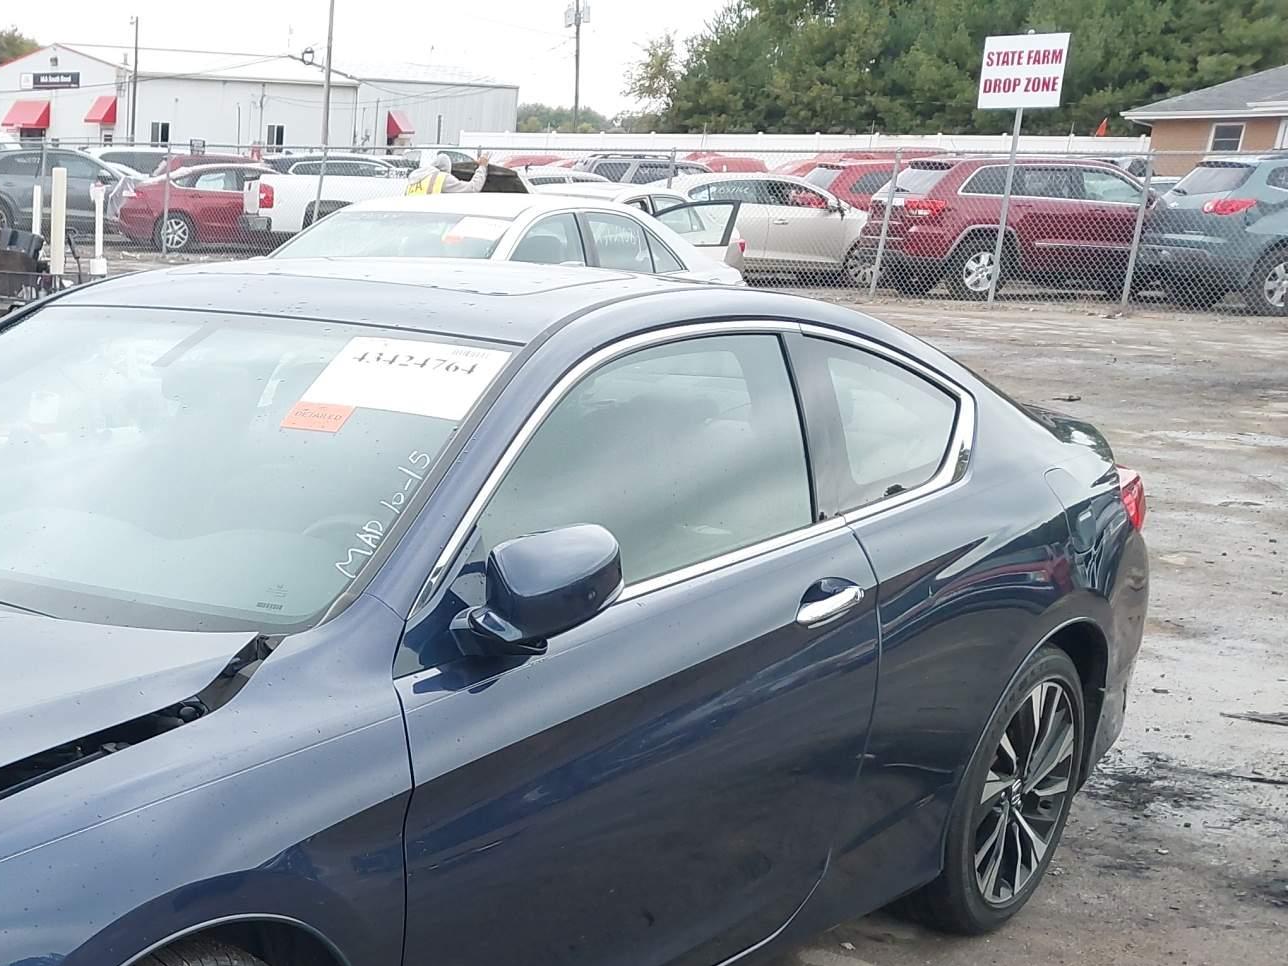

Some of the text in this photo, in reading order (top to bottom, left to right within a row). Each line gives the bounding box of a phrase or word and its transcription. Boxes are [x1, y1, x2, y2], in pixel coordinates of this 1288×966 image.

[986, 48, 1064, 67] STATE FARM
[983, 76, 1059, 94] DROP ZONE
[353, 351, 479, 375] 43424764
[294, 410, 343, 421] DETAILED
